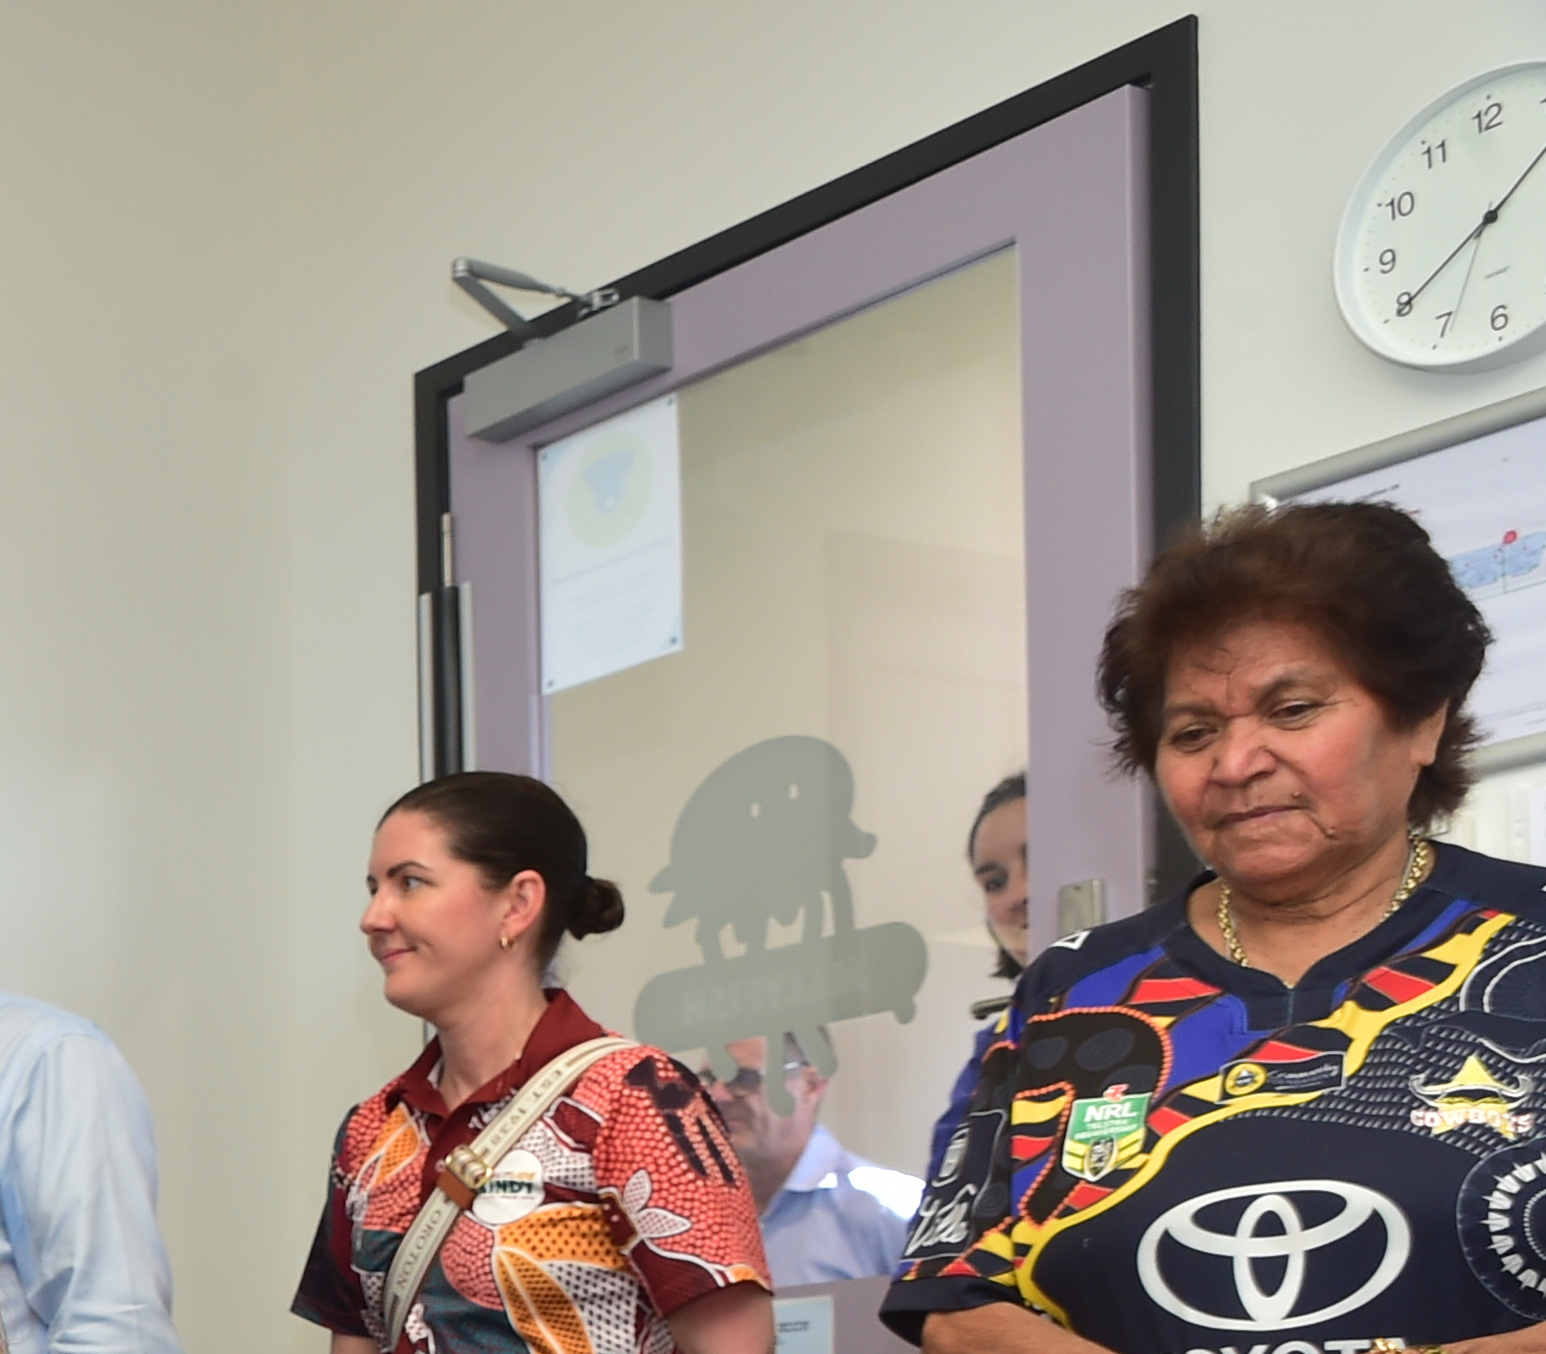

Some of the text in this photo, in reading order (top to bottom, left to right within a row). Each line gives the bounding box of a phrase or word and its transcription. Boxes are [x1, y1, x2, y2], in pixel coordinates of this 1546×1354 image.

[1471, 102, 1503, 134] 12
[1421, 139, 1447, 169] 11
[1385, 191, 1415, 221] 10
[1378, 248, 1397, 275] 9
[1396, 291, 1414, 318] 8
[1489, 304, 1509, 331] 6
[1435, 311, 1454, 338] 7
[1084, 1102, 1138, 1122] NRL
[1410, 1108, 1535, 1133] COWBOYS
[396, 1209, 440, 1289] OROTON
